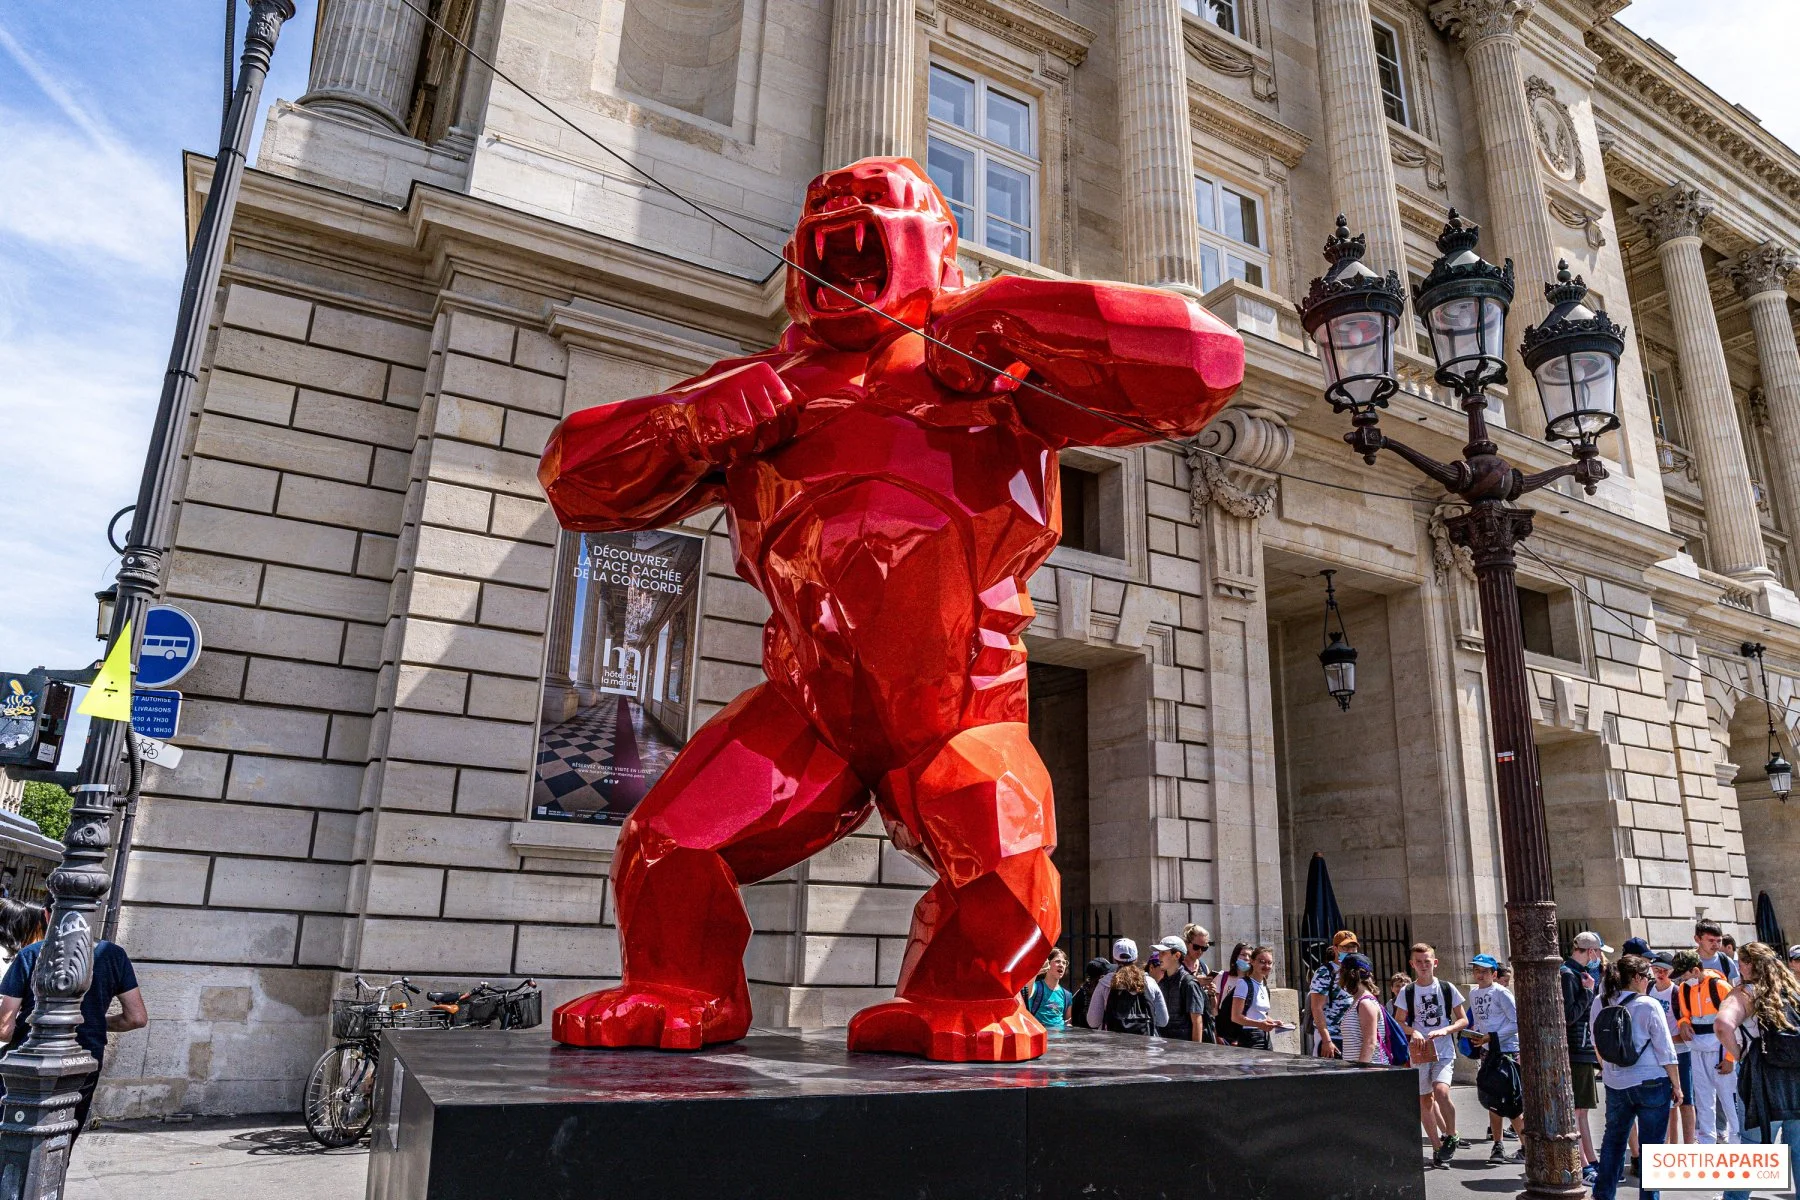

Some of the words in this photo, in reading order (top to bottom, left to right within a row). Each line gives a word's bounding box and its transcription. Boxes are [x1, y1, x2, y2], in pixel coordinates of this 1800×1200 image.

[577, 555, 592, 567] LA
[595, 558, 628, 573] FACE
[631, 565, 682, 583] CACHÉE
[593, 544, 669, 568] DÉCOUVREZ
[573, 567, 589, 579] DE
[593, 570, 607, 583] LA
[611, 574, 683, 595] CONCORDE
[601, 675, 609, 684] la
